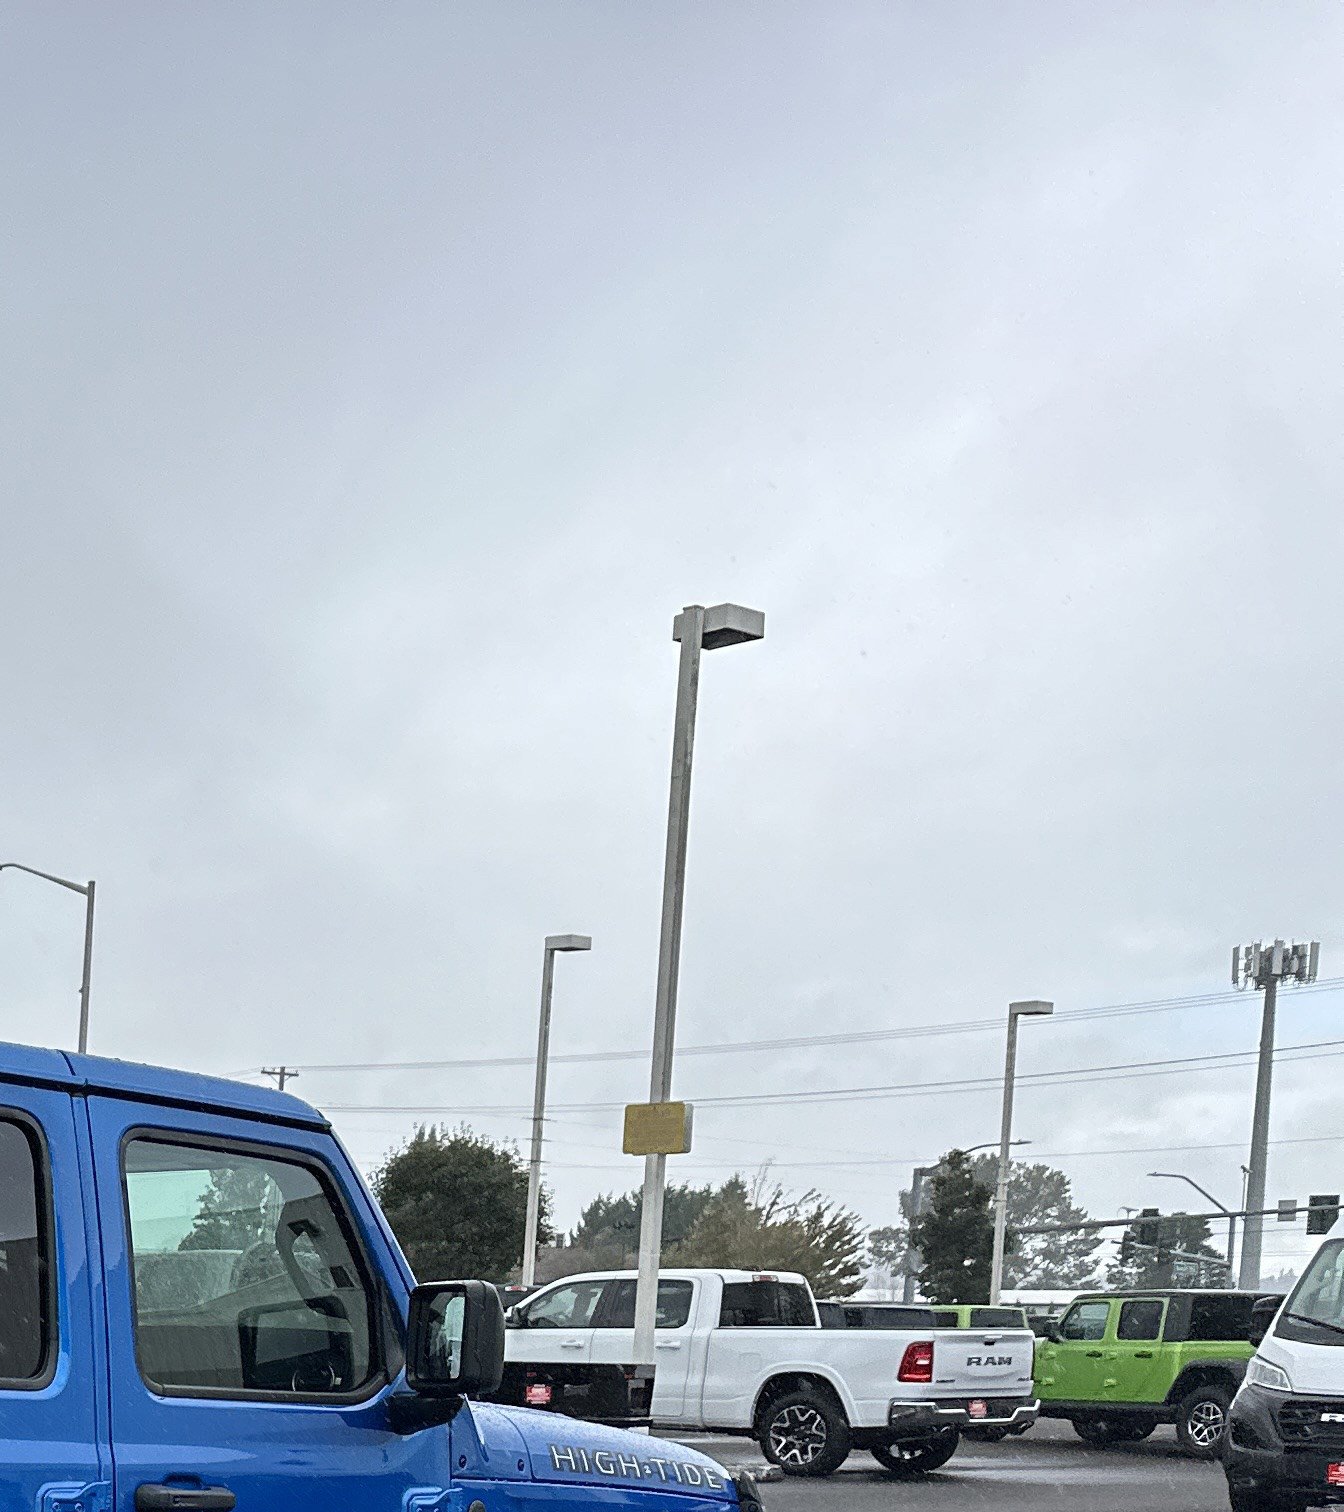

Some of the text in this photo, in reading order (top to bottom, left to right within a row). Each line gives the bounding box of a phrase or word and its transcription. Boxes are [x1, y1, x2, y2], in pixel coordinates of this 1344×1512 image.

[967, 1356, 1013, 1366] RAM
[549, 1444, 724, 1490] HIGH TIDE
